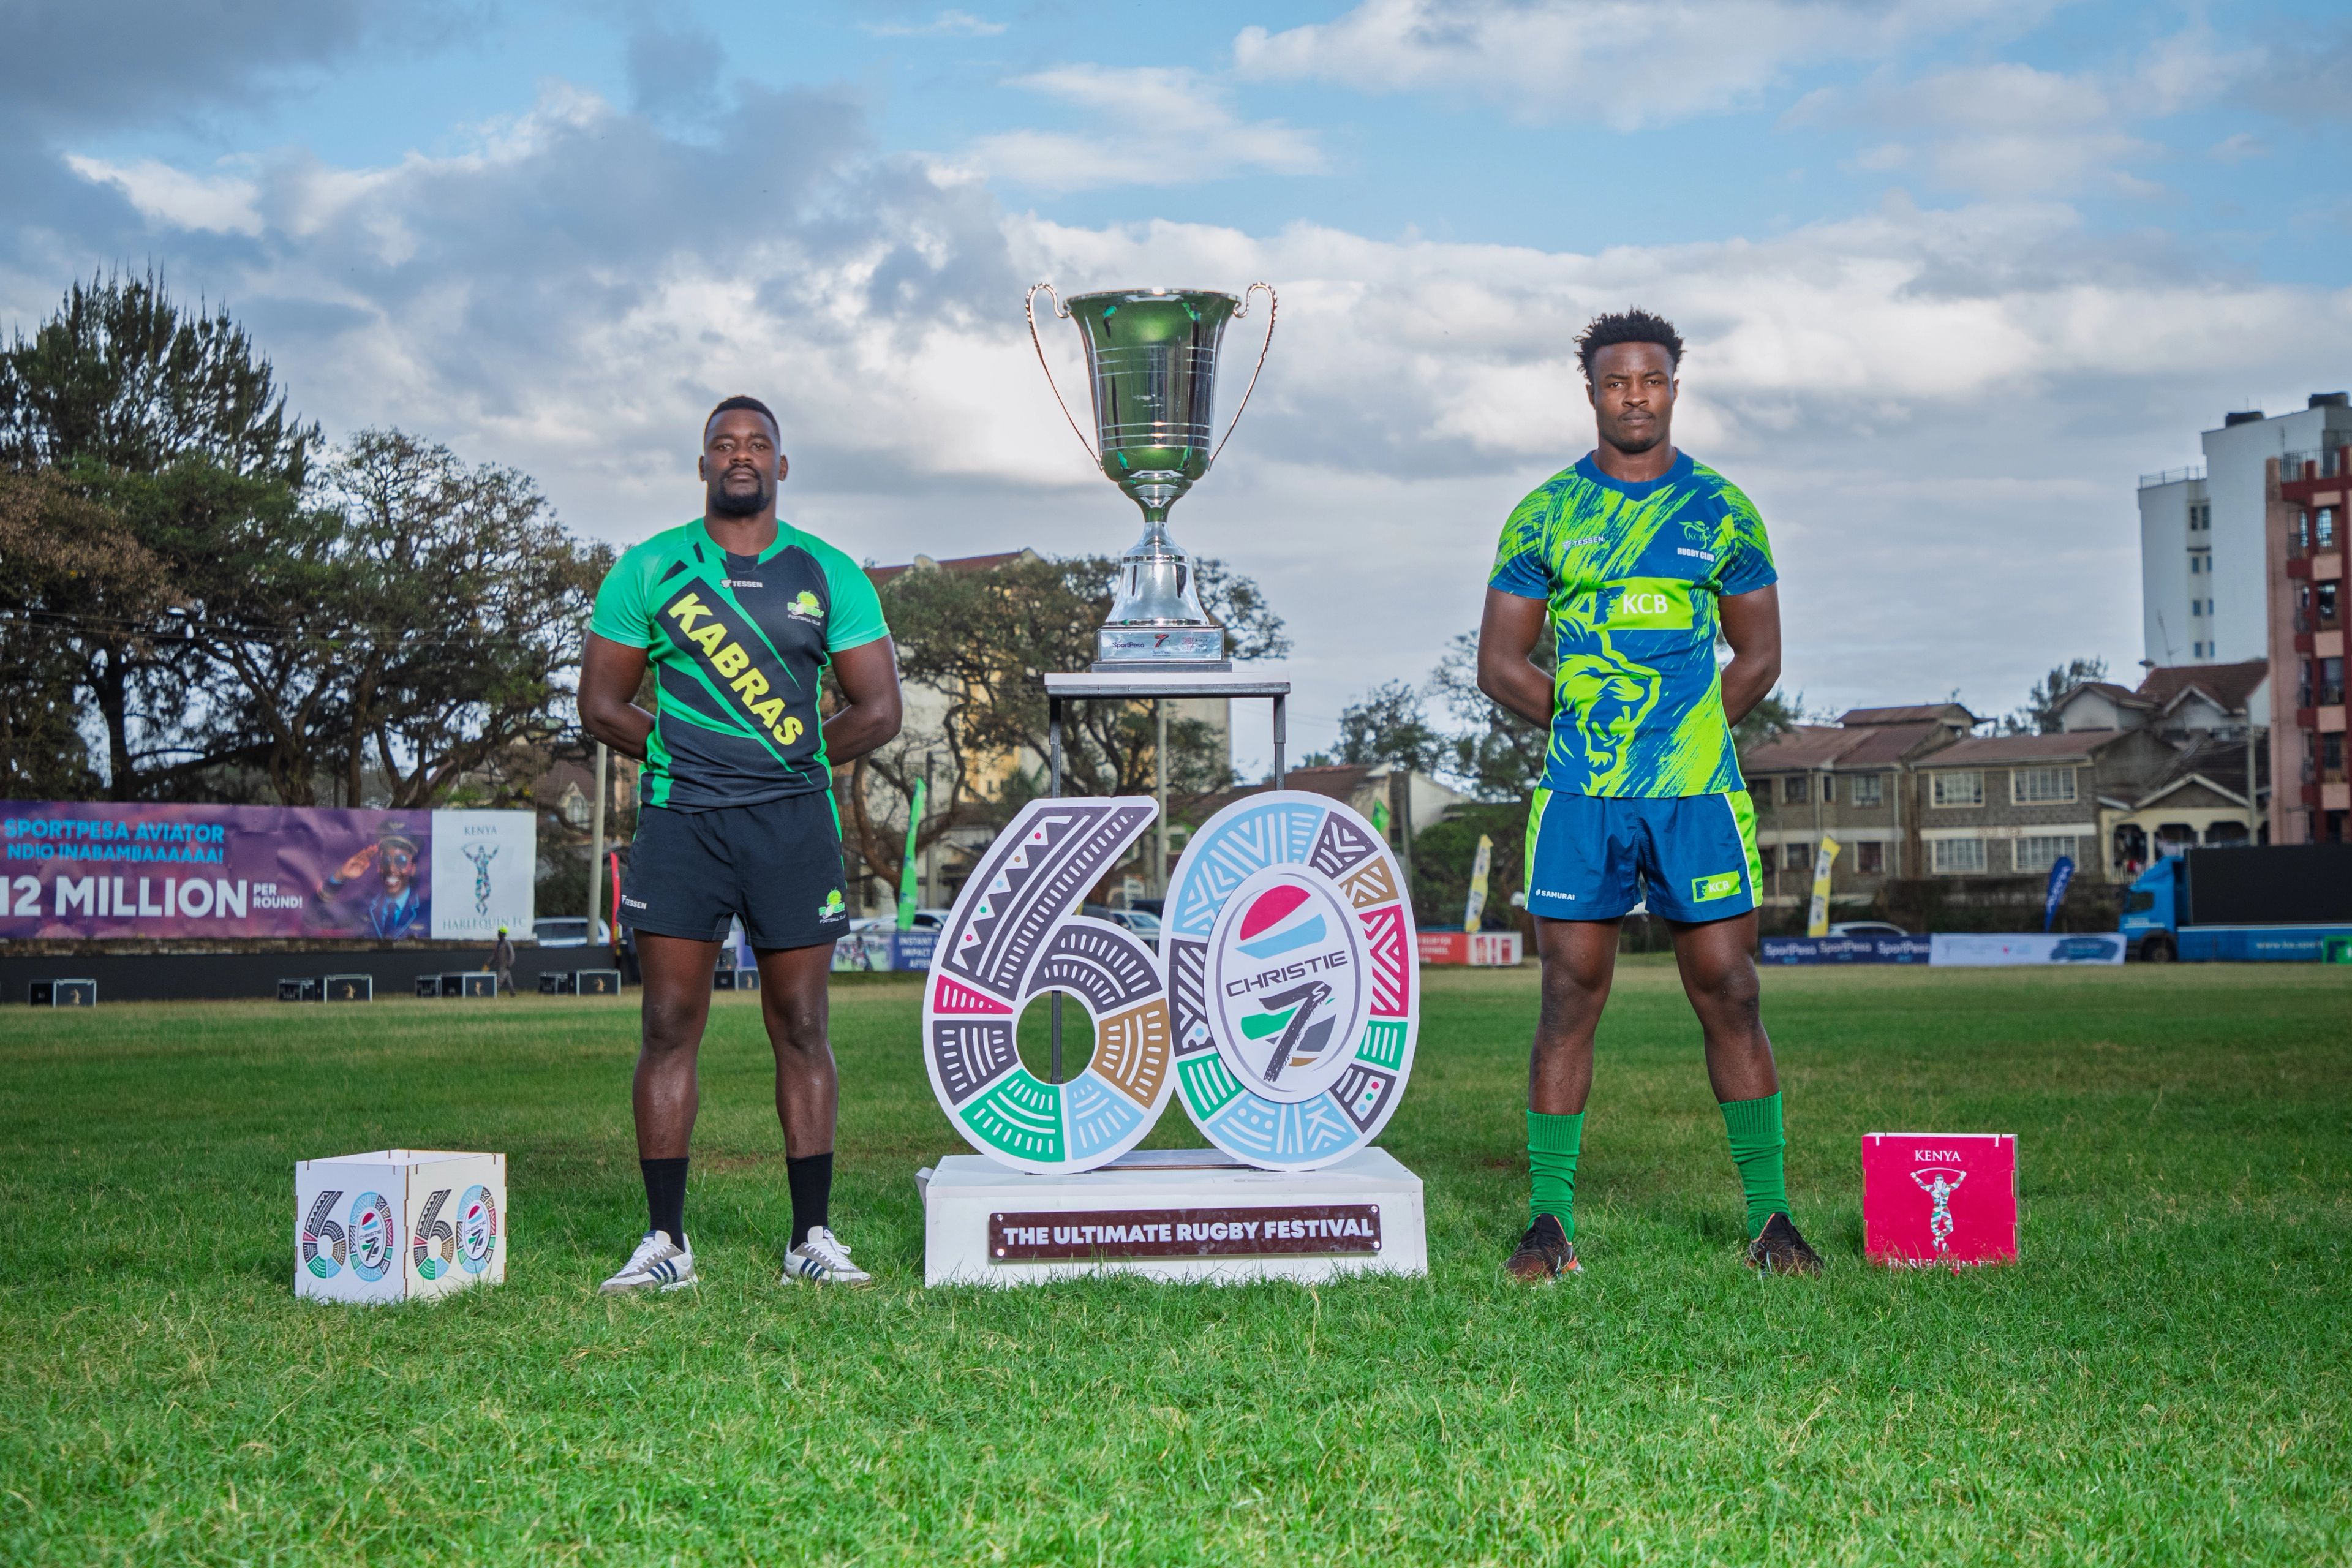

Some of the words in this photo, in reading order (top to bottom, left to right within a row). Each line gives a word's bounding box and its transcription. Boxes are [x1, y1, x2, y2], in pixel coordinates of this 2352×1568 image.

[1574, 535, 1604, 546] TESSEN
[1677, 548, 1700, 558] RUGBY
[1700, 551, 1715, 562] CLUB
[1623, 593, 1668, 614] KCB
[788, 614, 812, 623] FOOTBALL
[668, 592, 804, 745] KABRAS
[4, 818, 129, 840] SPORTPESA
[135, 822, 224, 843] AVIATOR
[464, 825, 497, 835] KENYA
[7, 843, 55, 860] NDIO
[253, 882, 277, 896] PER
[1709, 880, 1730, 893] KCB
[0, 875, 42, 916] 12
[55, 875, 247, 918] MILLION
[253, 895, 303, 909] ROUND!
[1541, 890, 1575, 900] SAMURAI
[625, 898, 647, 910] TESSEN
[443, 918, 508, 931] HARLEQUIN
[1764, 942, 1817, 958] SportPesa
[1817, 940, 1872, 955] SportPesa
[908, 959, 930, 969] AFTE
[1226, 950, 1348, 997] CHRISTIE
[1915, 1150, 1961, 1162] KENYA
[359, 1229, 382, 1240] CHRISTIE
[1003, 1227, 1049, 1245] THE
[1054, 1224, 1172, 1245] ULTIMATE
[1177, 1221, 1260, 1242] RUGBY
[1264, 1218, 1374, 1239] FESTIVAL
